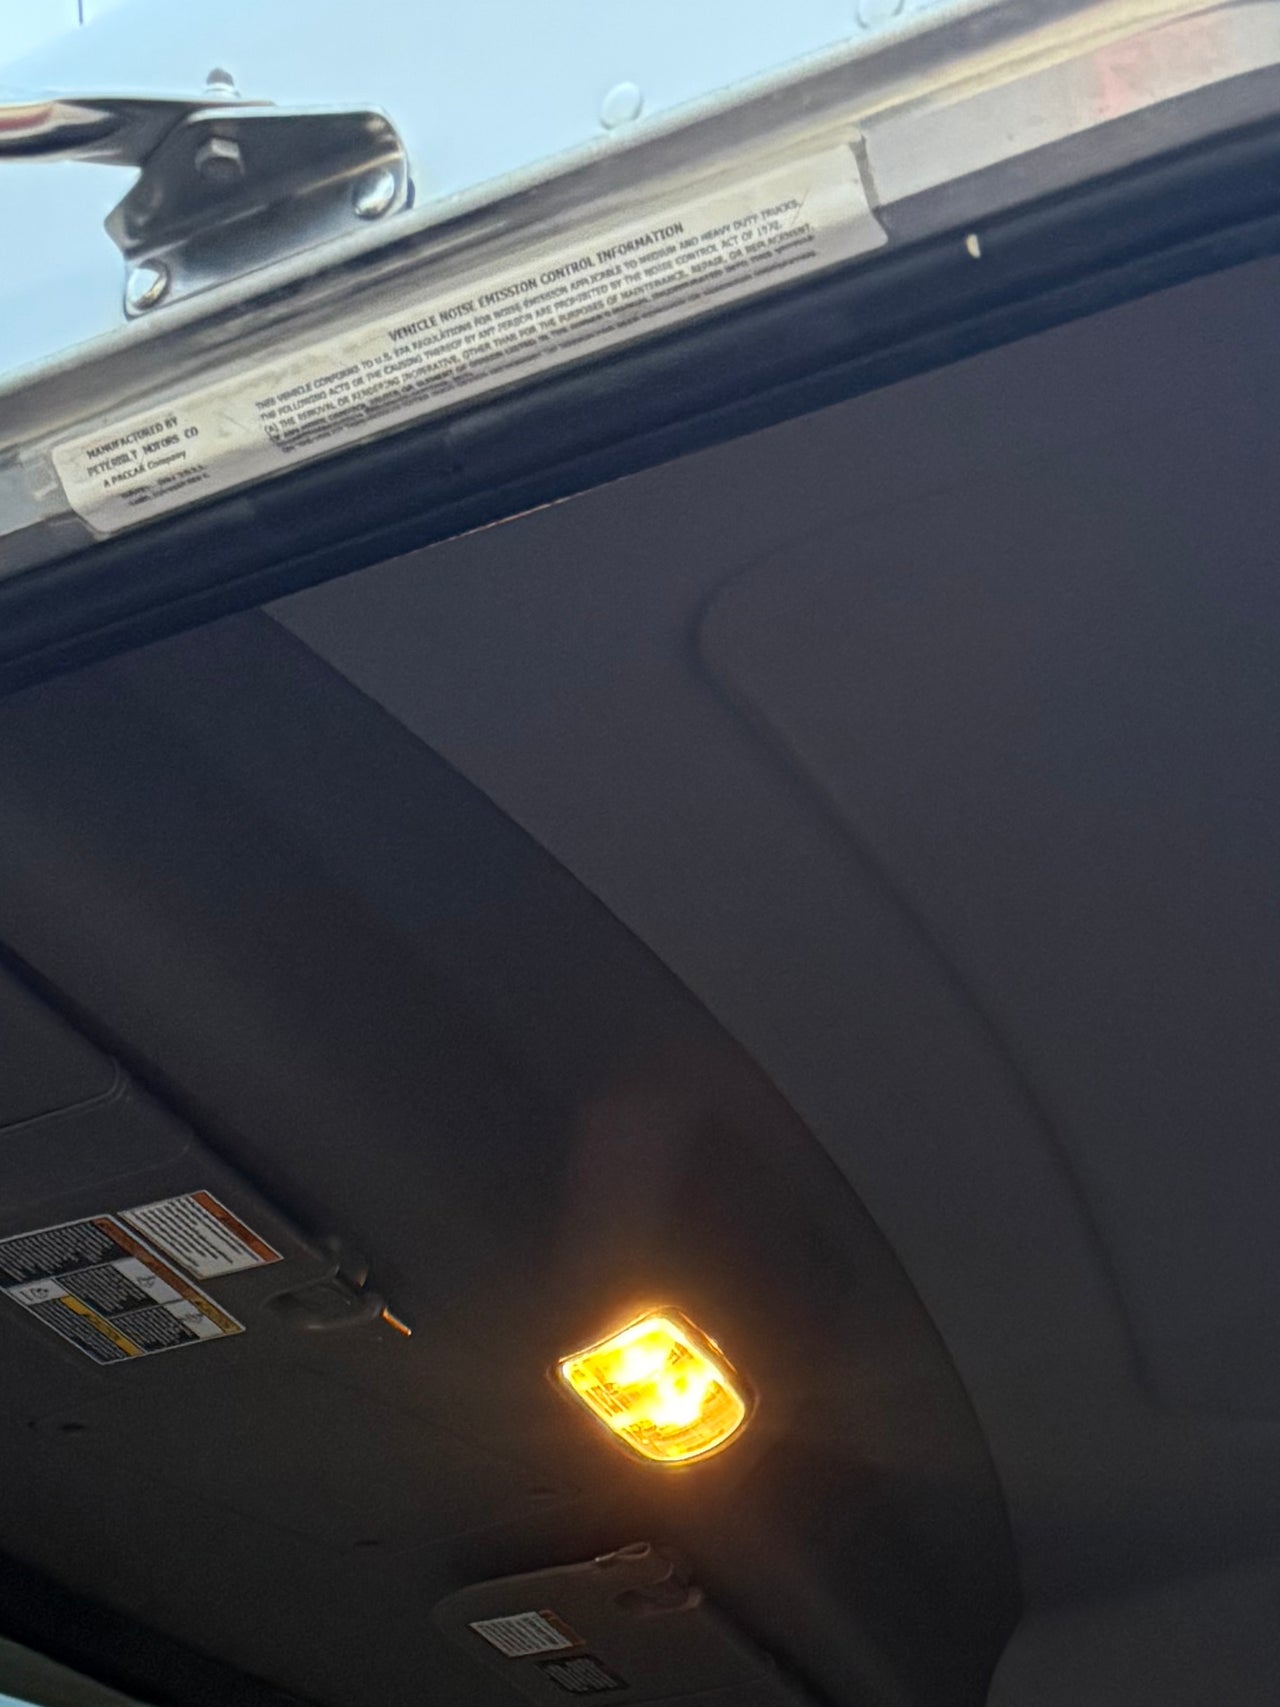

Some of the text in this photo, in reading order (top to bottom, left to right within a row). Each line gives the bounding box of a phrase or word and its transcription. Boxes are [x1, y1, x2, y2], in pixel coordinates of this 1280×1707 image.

[327, 381, 350, 395] ACTS
[366, 369, 382, 381] THE
[382, 353, 423, 375] CAUSING
[463, 333, 477, 344] BY
[533, 304, 552, 318] ARE
[609, 278, 623, 290] BY
[623, 270, 642, 284] THE
[673, 243, 718, 266] CONTROL
[719, 235, 739, 249] ACT
[740, 229, 754, 241] OF
[361, 359, 374, 370] TO
[472, 313, 492, 326] FOR
[625, 259, 638, 269] TO
[678, 236, 699, 250] AND
[699, 223, 732, 242] HEAVY
[732, 213, 758, 230] DUTY
[387, 221, 684, 342] VEHICLE NOISE EMISSION CONTROL INFORMATION
[278, 415, 296, 428] THE
[336, 395, 350, 406] OR
[461, 341, 491, 359] OTHER
[518, 324, 538, 338] FOR
[538, 317, 557, 330] THE
[605, 293, 619, 305] OF
[85, 416, 178, 459] MANUFACTURED BY
[86, 425, 199, 476] PETERBILT MOTORS CO
[110, 464, 146, 483] PACCAR
[146, 449, 187, 471] Company
